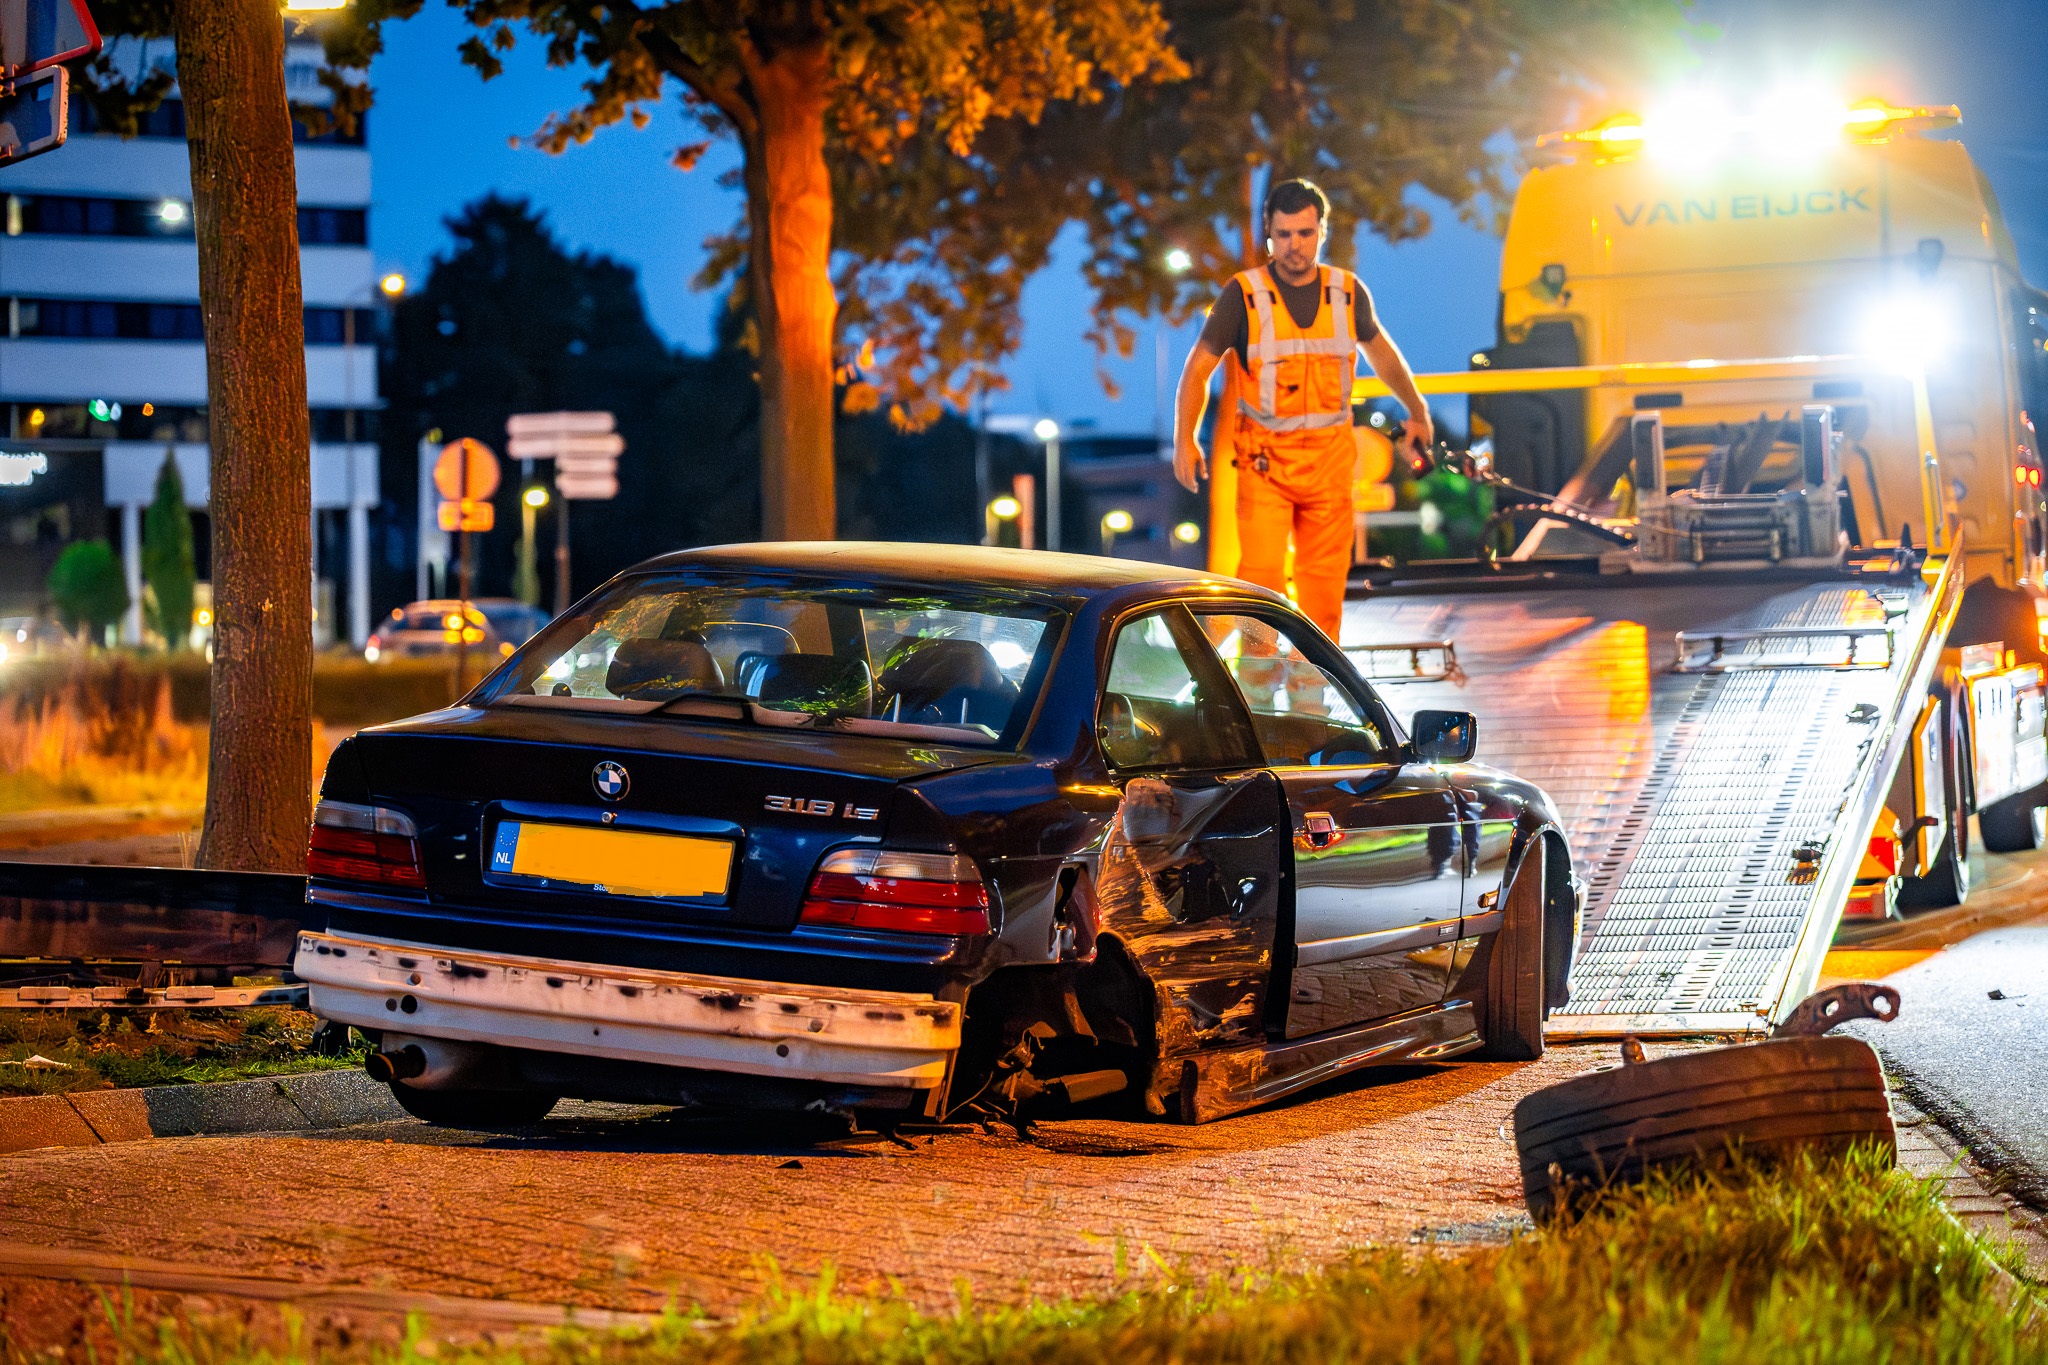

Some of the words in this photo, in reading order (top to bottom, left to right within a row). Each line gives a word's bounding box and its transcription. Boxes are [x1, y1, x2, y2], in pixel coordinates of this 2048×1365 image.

[1614, 196, 1718, 227] VAN
[1731, 187, 1870, 220] EIJCK
[594, 762, 627, 777] BMW
[763, 795, 835, 817] 318
[495, 851, 511, 864] NL
